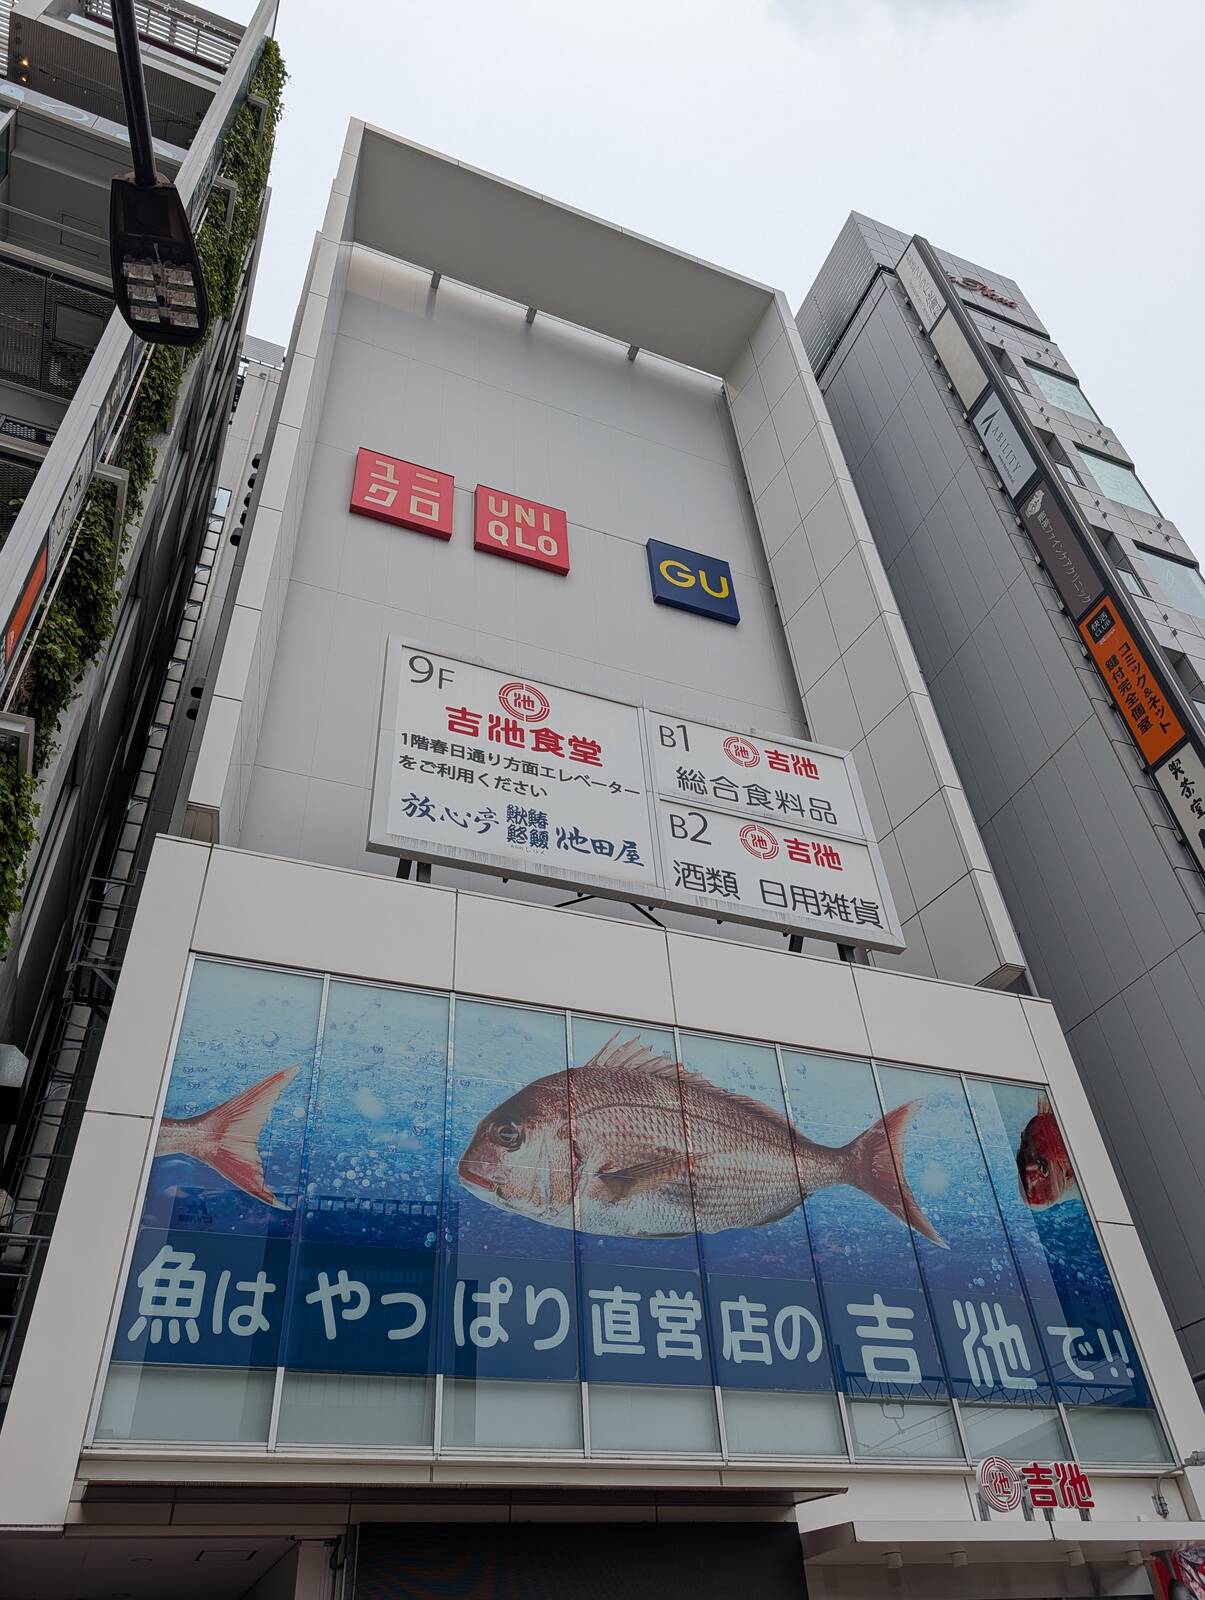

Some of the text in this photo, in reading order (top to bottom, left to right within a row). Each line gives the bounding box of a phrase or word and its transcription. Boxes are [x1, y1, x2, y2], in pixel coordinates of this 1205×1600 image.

[992, 426, 1022, 473] ABILITY
[659, 559, 730, 599] GU
[408, 655, 456, 690] 9F
[445, 705, 603, 768] 吉池食堂
[659, 724, 690, 752] B1
[398, 754, 548, 798] をご利用ください
[400, 732, 641, 796] 1階春日通り方面エレベーター
[764, 749, 821, 781] 吉池
[675, 766, 838, 825] 総合食料品
[555, 826, 645, 868] 池田屋
[669, 812, 712, 846] B2
[783, 837, 844, 872] 吉池
[1020, 1461, 1096, 1510] 吉池
